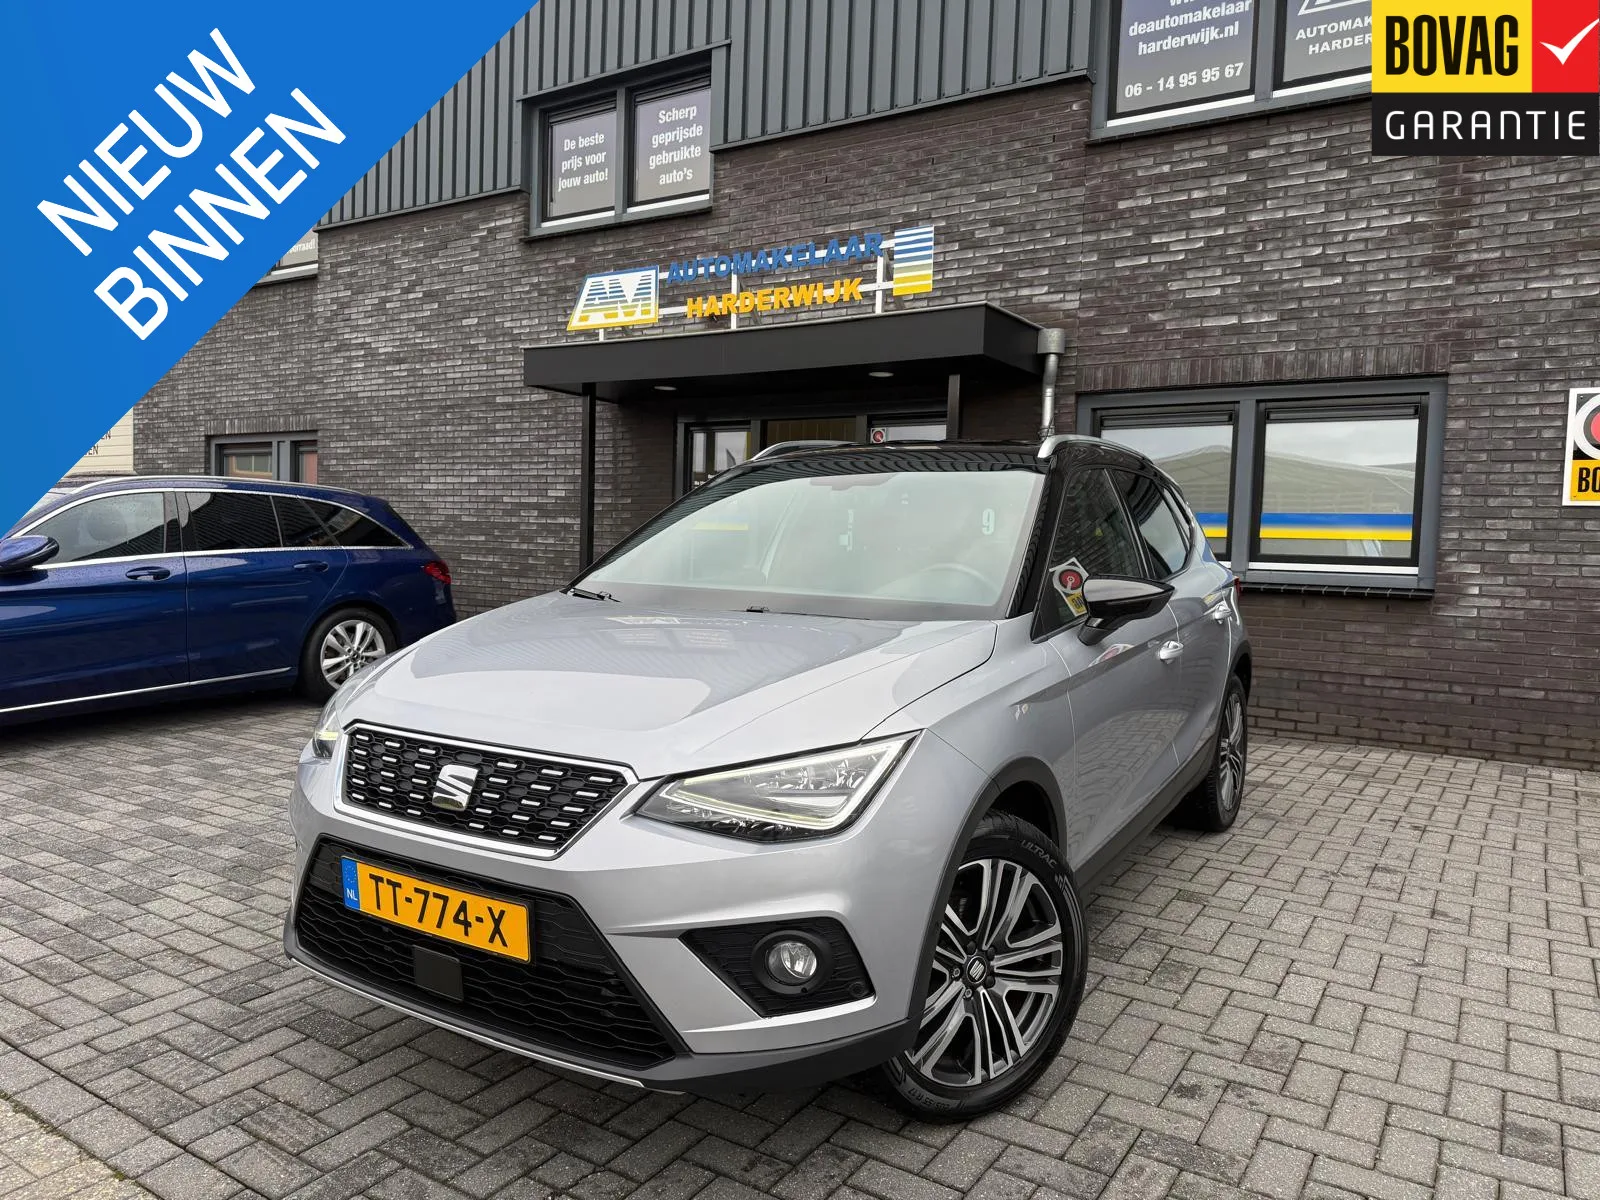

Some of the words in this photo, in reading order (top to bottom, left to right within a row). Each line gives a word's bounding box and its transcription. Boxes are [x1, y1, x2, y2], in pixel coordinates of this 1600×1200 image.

[1128, 0, 1253, 37] deautomakelaar
[1138, 21, 1239, 56] harderwijk.nl
[1124, 82, 1143, 98] 06
[1157, 75, 1175, 92] 14
[1178, 71, 1197, 88] 95
[1201, 66, 1220, 83] 95
[1224, 62, 1244, 79] 67
[658, 105, 697, 124] Scherp
[563, 138, 576, 152] De
[578, 132, 605, 148] beste
[652, 124, 703, 148] geprijsde
[561, 154, 583, 174] prijs
[584, 151, 607, 167] voor
[649, 145, 701, 170] gebruikte
[558, 175, 581, 193] jouw
[583, 168, 608, 186] auto!
[659, 168, 693, 186] auto's
[666, 232, 885, 284] AUTOMAKELAAR
[686, 277, 863, 319] HARDERWIJK
[1020, 839, 1058, 869] ULTRAC
[346, 887, 358, 901] NL
[368, 873, 508, 948] TT-774-X
